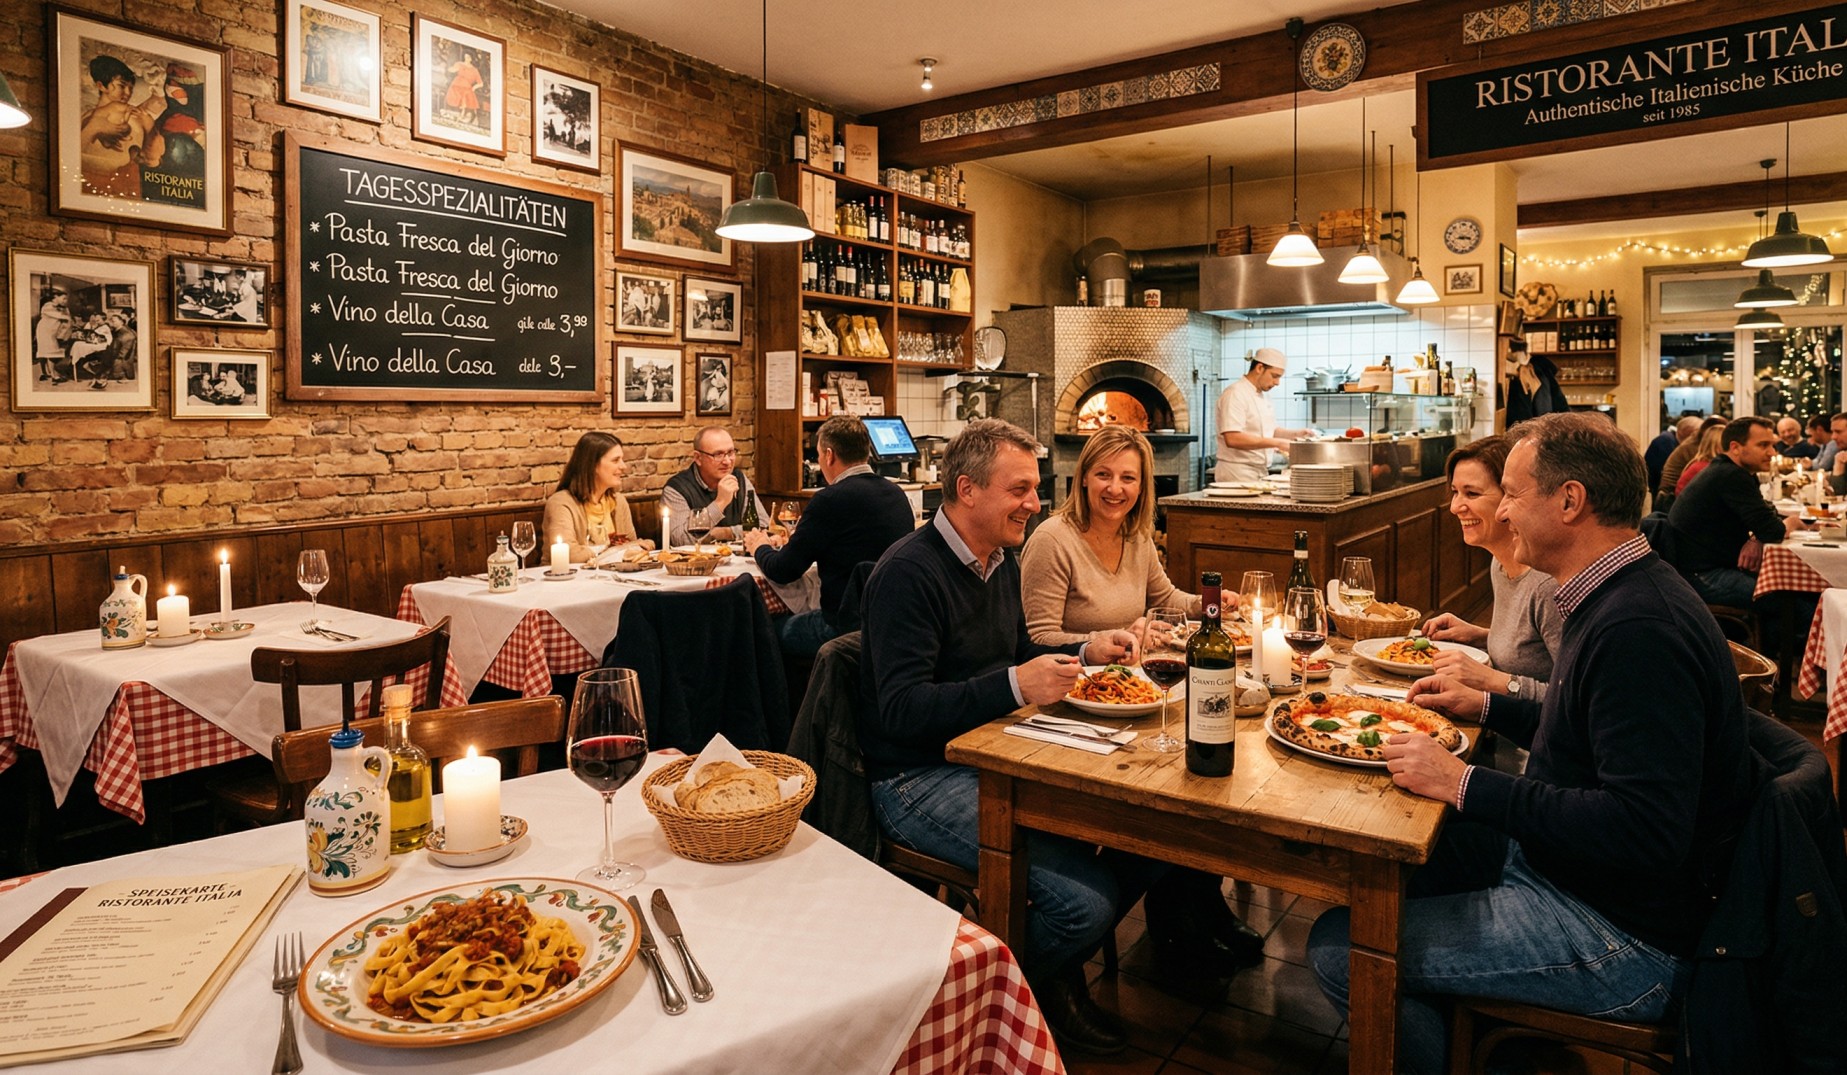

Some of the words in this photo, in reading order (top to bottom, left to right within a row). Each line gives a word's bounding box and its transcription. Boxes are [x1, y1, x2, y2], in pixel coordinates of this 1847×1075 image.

[1475, 37, 1731, 108] RISTORANTE
[1744, 17, 1847, 63] ITAL
[1524, 92, 1644, 125] Authentische
[1650, 73, 1765, 105] Italienische
[1772, 60, 1843, 86] Küche
[1642, 109, 1665, 123] seit
[1670, 103, 1700, 119] 1985
[144, 171, 203, 190] RISTORANTE
[161, 186, 194, 200] ITALIA
[339, 168, 566, 229] TAGESSPEZIALITÄTEN
[324, 212, 390, 246] Pasta
[397, 222, 461, 254] Fresca
[468, 234, 496, 258] del
[501, 237, 559, 270] Giorno
[326, 252, 390, 284] Pasta
[395, 260, 461, 290] Fresca
[467, 269, 495, 292] del
[501, 273, 558, 305] Giorno
[328, 294, 377, 322] Vino
[385, 300, 435, 326] della
[441, 304, 489, 330] Casa
[329, 343, 379, 372] Vino
[388, 347, 440, 373] della
[446, 348, 496, 375] Casa
[97, 895, 193, 907] RISTORANTE
[195, 889, 243, 903] ITALIA
[127, 883, 228, 898] SPEISEKARTE
